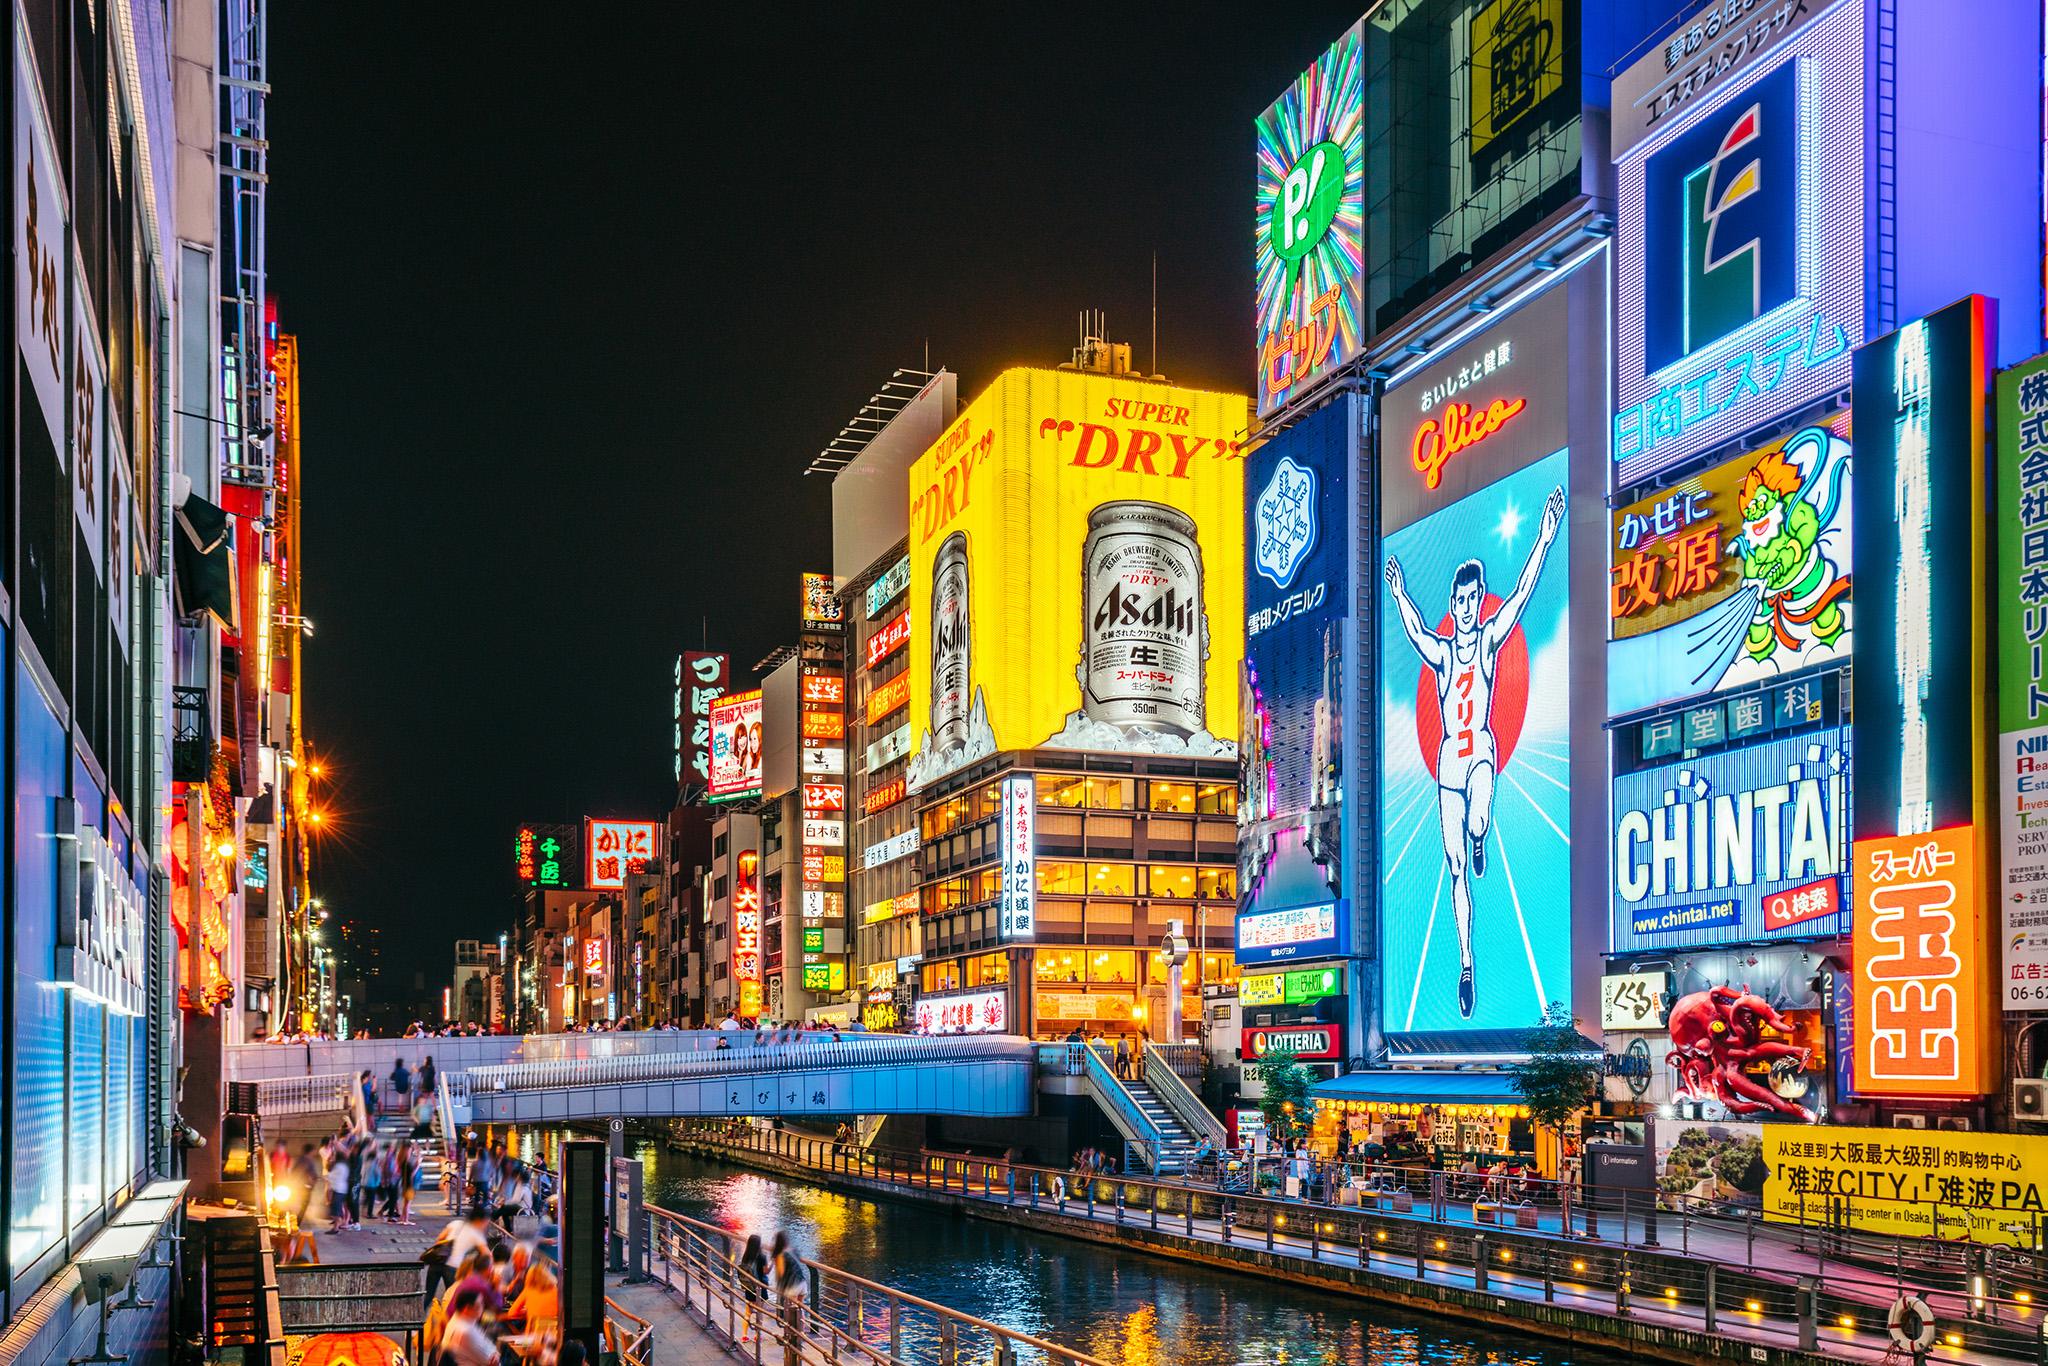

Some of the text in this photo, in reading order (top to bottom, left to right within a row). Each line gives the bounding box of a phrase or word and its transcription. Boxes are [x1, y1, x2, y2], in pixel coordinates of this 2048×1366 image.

[1265, 283, 1343, 394] ピップ
[1420, 341, 1512, 412] おいしさと健康
[1614, 313, 1848, 462] 日商エステム
[1104, 397, 1191, 427] SUPER
[934, 418, 971, 471] SUPER
[1617, 486, 1714, 551] かぜに
[1123, 545, 1160, 557] BREWERIES
[1162, 553, 1184, 579] LIMITED
[1608, 521, 1722, 620] 改源
[1093, 581, 1194, 638] Asahi
[1248, 583, 1326, 636] 雪印メグミルク
[1129, 645, 1160, 667] 生
[1116, 670, 1174, 685] スーパードライ
[1132, 702, 1158, 715] 350ml
[1456, 665, 1477, 758] グリコ
[1650, 682, 1812, 752] 戸堂歯科
[1810, 704, 1820, 719] 3F
[811, 775, 823, 783] 5F
[804, 787, 842, 809] はや
[596, 827, 648, 854] かに
[805, 824, 841, 838] 白木屋
[1616, 772, 1845, 904] CHINTAI
[1869, 841, 1956, 882] スーパー
[1792, 888, 1829, 918] 検索
[1823, 972, 1834, 1010] 2F
[1866, 879, 1962, 1081] 玉出
[1267, 1033, 1323, 1050] LOTTERIA
[730, 1091, 827, 1106] えびす橋
[1435, 1130, 1455, 1144] お好み
[1465, 1130, 1499, 1147] 兄貴の店
[1609, 1156, 1638, 1166] information
[1866, 1208, 1892, 1220] center
[1894, 1208, 1902, 1221] in
